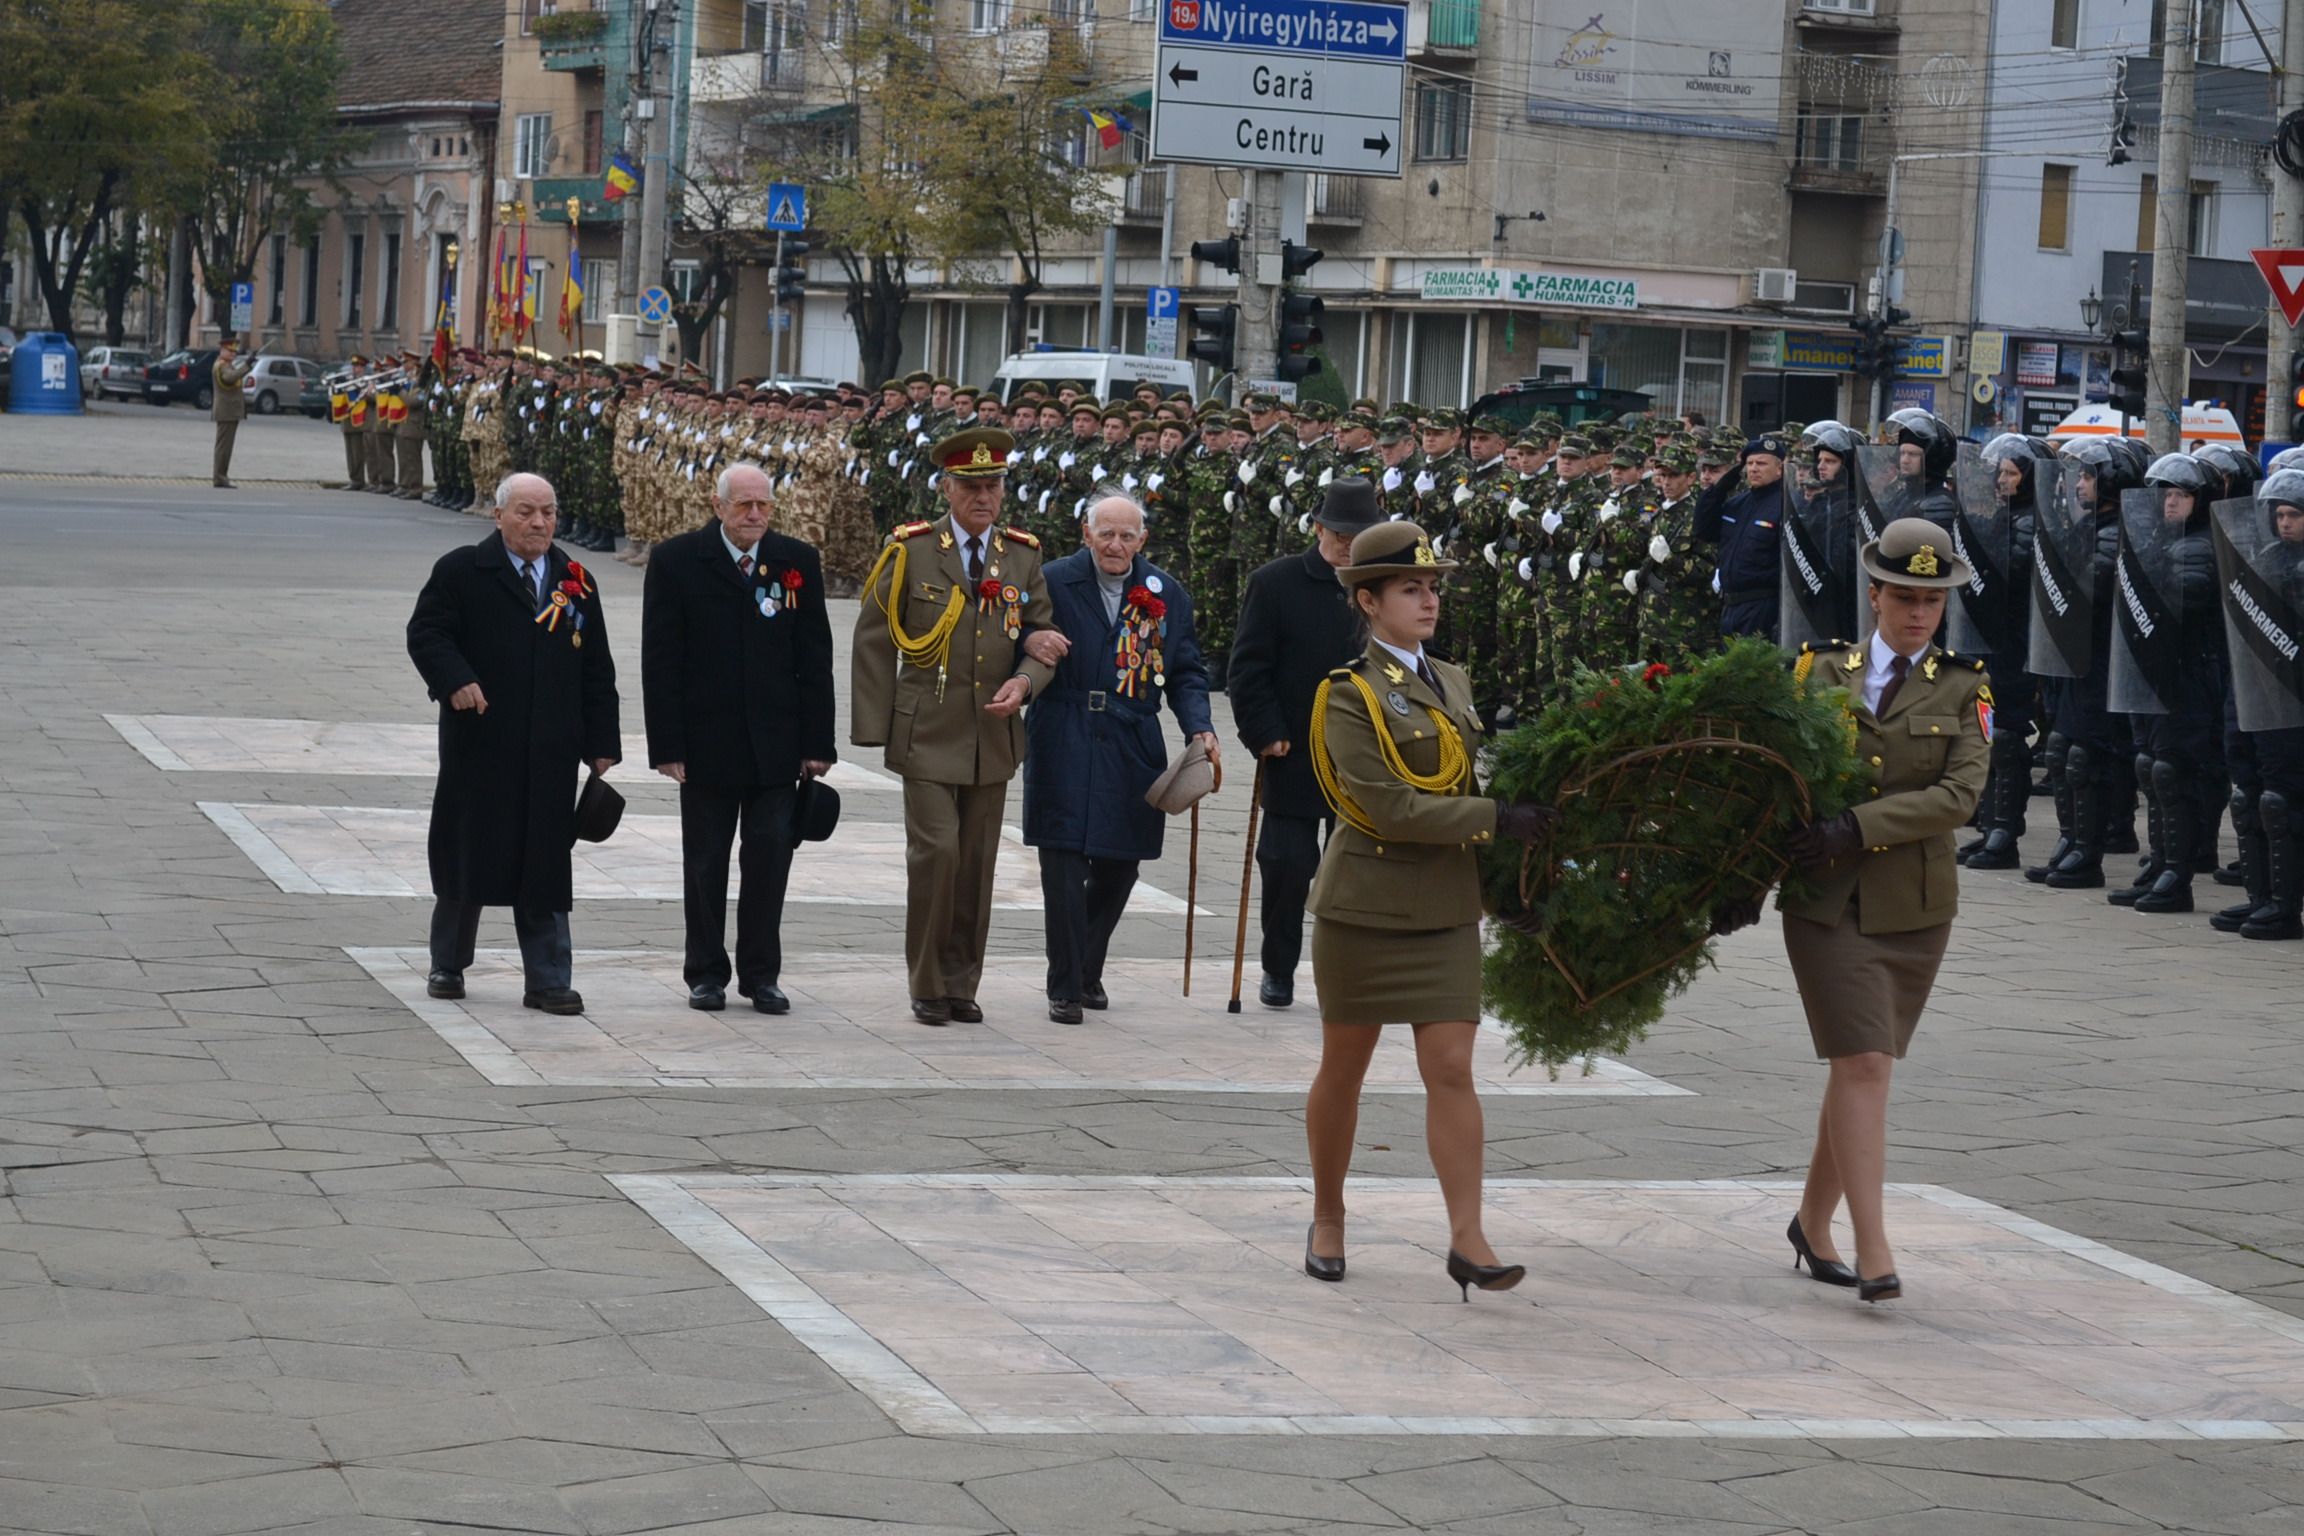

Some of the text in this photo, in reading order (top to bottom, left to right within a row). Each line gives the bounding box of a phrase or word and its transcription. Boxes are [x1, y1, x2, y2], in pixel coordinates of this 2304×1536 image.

[1174, 2, 1368, 46] 19A Nyiregyháza
[1253, 66, 1313, 100] Gară
[1575, 71, 1616, 85] LISSIM
[1686, 79, 1752, 95] KÖMMERLING
[1237, 119, 1324, 155] Centru
[1424, 272, 1486, 286] FARMACIA
[1424, 286, 1474, 297] HUMANITAS
[1536, 276, 1635, 296] FARMACIA
[1534, 290, 1616, 305] HUMANITAS
[1624, 297, 1634, 307] H
[1895, 388, 1931, 401] AMANET
[1784, 520, 1823, 595] JANDARMERIA
[2033, 533, 2069, 616] JANDARMERIA
[2117, 553, 2155, 639] JANDARMERIA
[2229, 579, 2300, 661] JANDARMERIA
